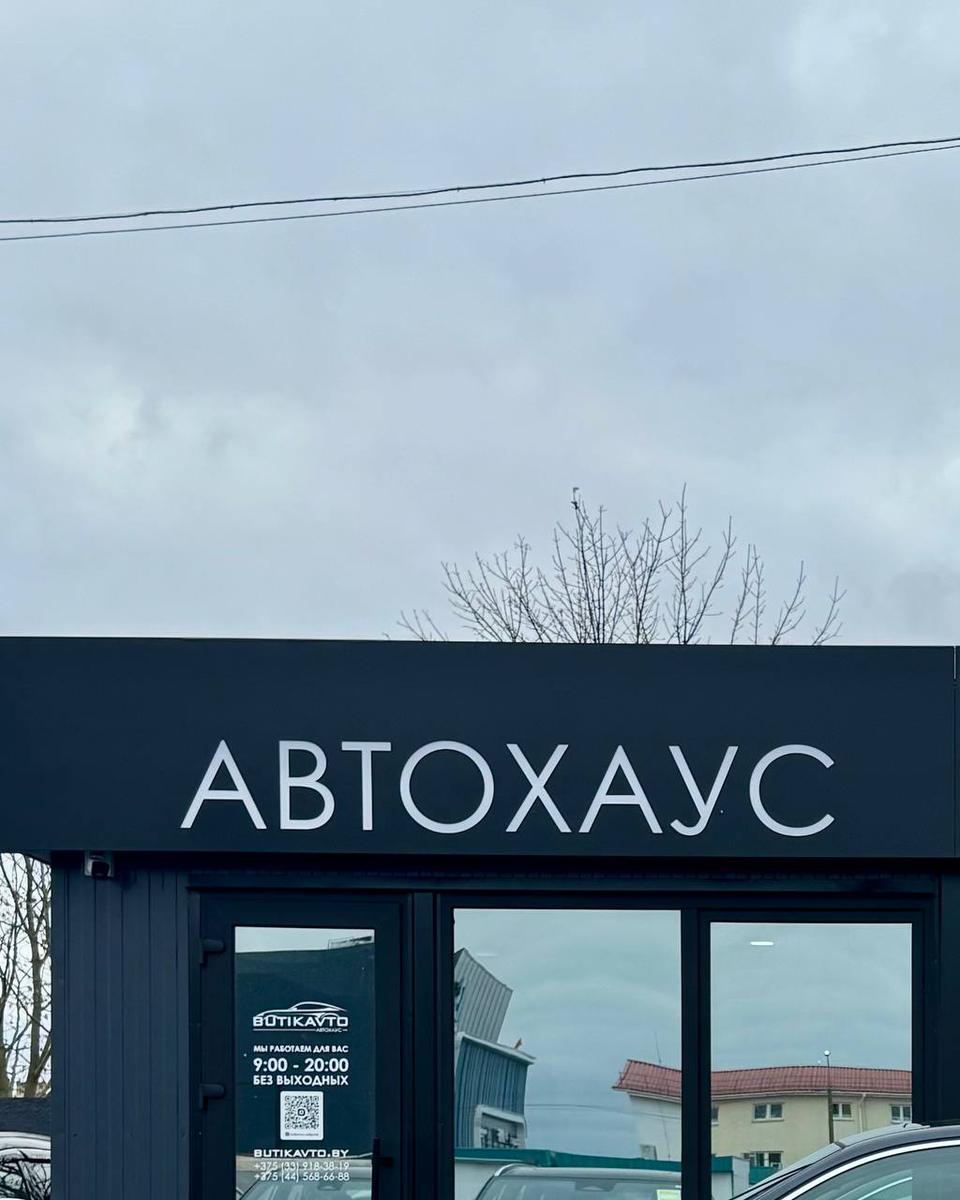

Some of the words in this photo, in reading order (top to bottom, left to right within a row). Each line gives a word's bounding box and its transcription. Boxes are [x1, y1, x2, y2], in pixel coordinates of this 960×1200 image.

[180, 739, 837, 837] АВТОХАУС
[252, 1016, 349, 1027] BUTIKAVTO
[253, 1045, 268, 1053] МЫ
[269, 1045, 312, 1053] РАБОТАЕМ
[313, 1045, 330, 1053] ДЛЯ
[331, 1045, 349, 1053] ВАС
[253, 1057, 288, 1072] 9:00
[304, 1057, 349, 1072] 20:00
[253, 1075, 273, 1085] БЕЗ
[276, 1075, 349, 1086] ВЫХОДНЫХ
[253, 1149, 349, 1158] BUTIKAVTO.BY
[254, 1161, 278, 1171] +375
[281, 1161, 299, 1172] (33)
[302, 1161, 350, 1171] 918-38-19
[254, 1172, 278, 1181] +375
[281, 1171, 299, 1183] (44)
[302, 1172, 350, 1181] 568-66-88
